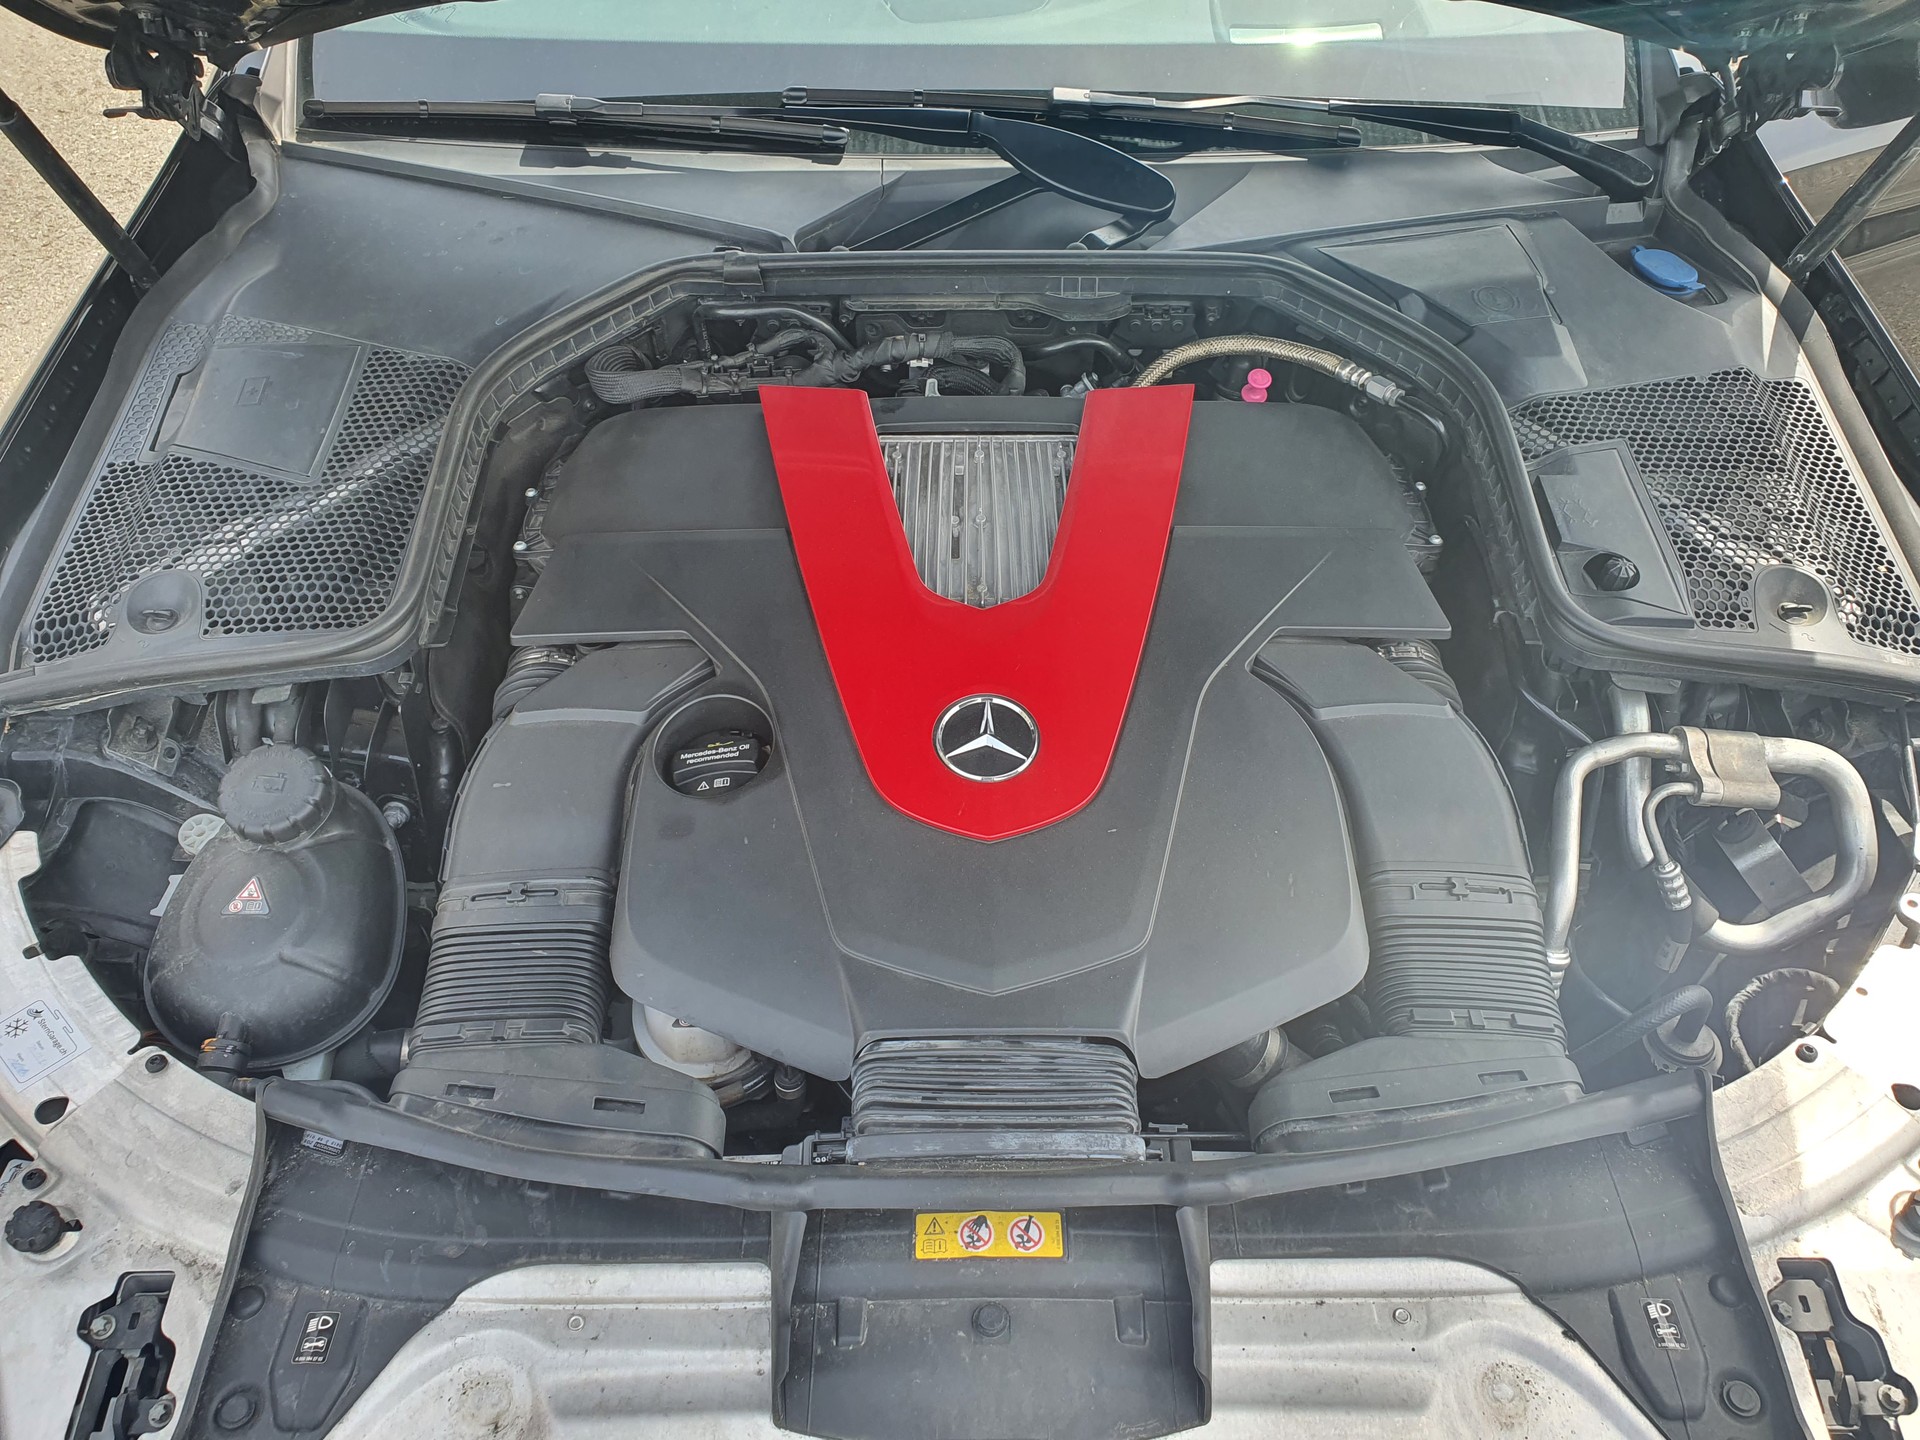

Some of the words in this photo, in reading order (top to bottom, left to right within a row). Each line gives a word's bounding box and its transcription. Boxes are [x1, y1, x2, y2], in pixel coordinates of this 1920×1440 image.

[680, 746, 737, 759] Mercedes-Benz
[687, 752, 739, 764] recommended
[37, 1018, 68, 1056] SternGarage.ch
